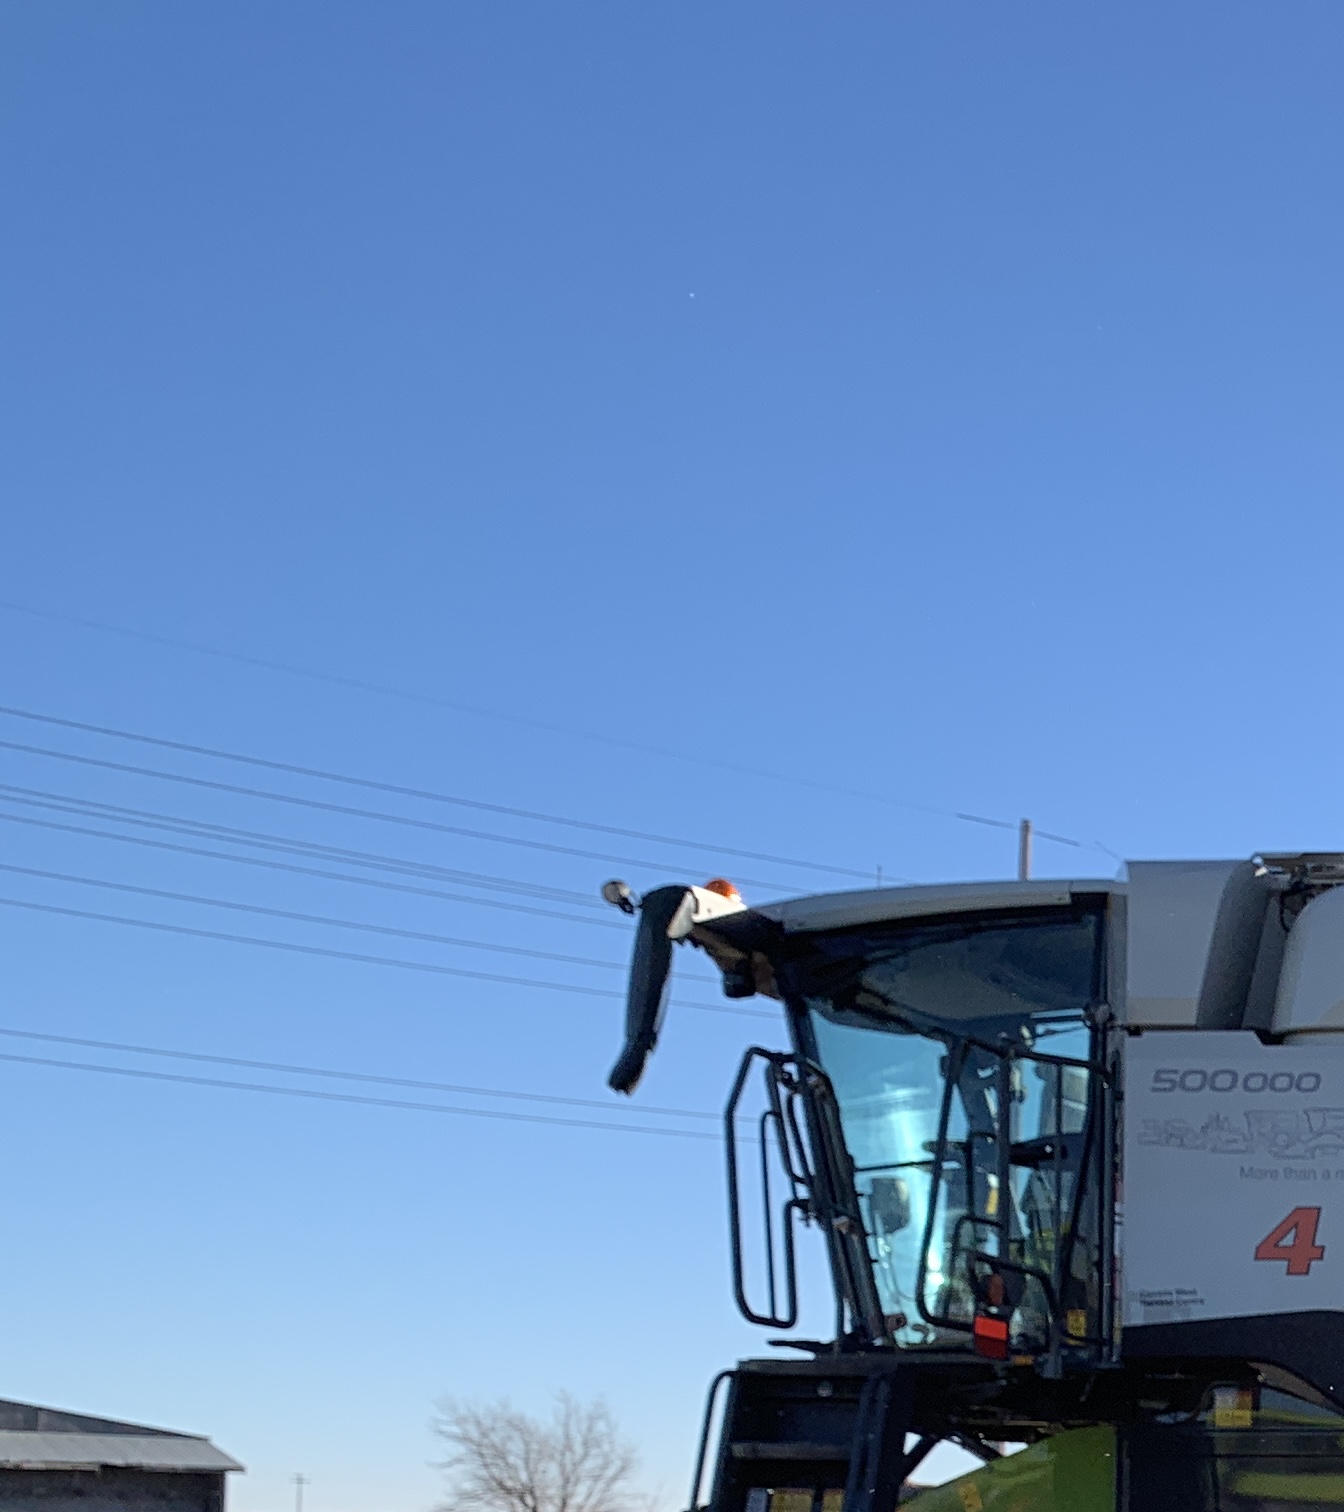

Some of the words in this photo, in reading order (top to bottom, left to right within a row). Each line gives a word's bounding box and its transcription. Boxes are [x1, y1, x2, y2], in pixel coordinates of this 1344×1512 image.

[1238, 1165, 1279, 1181] More
[1283, 1166, 1317, 1181] than
[1321, 1168, 1331, 1181] a
[1254, 1206, 1325, 1276] 4
